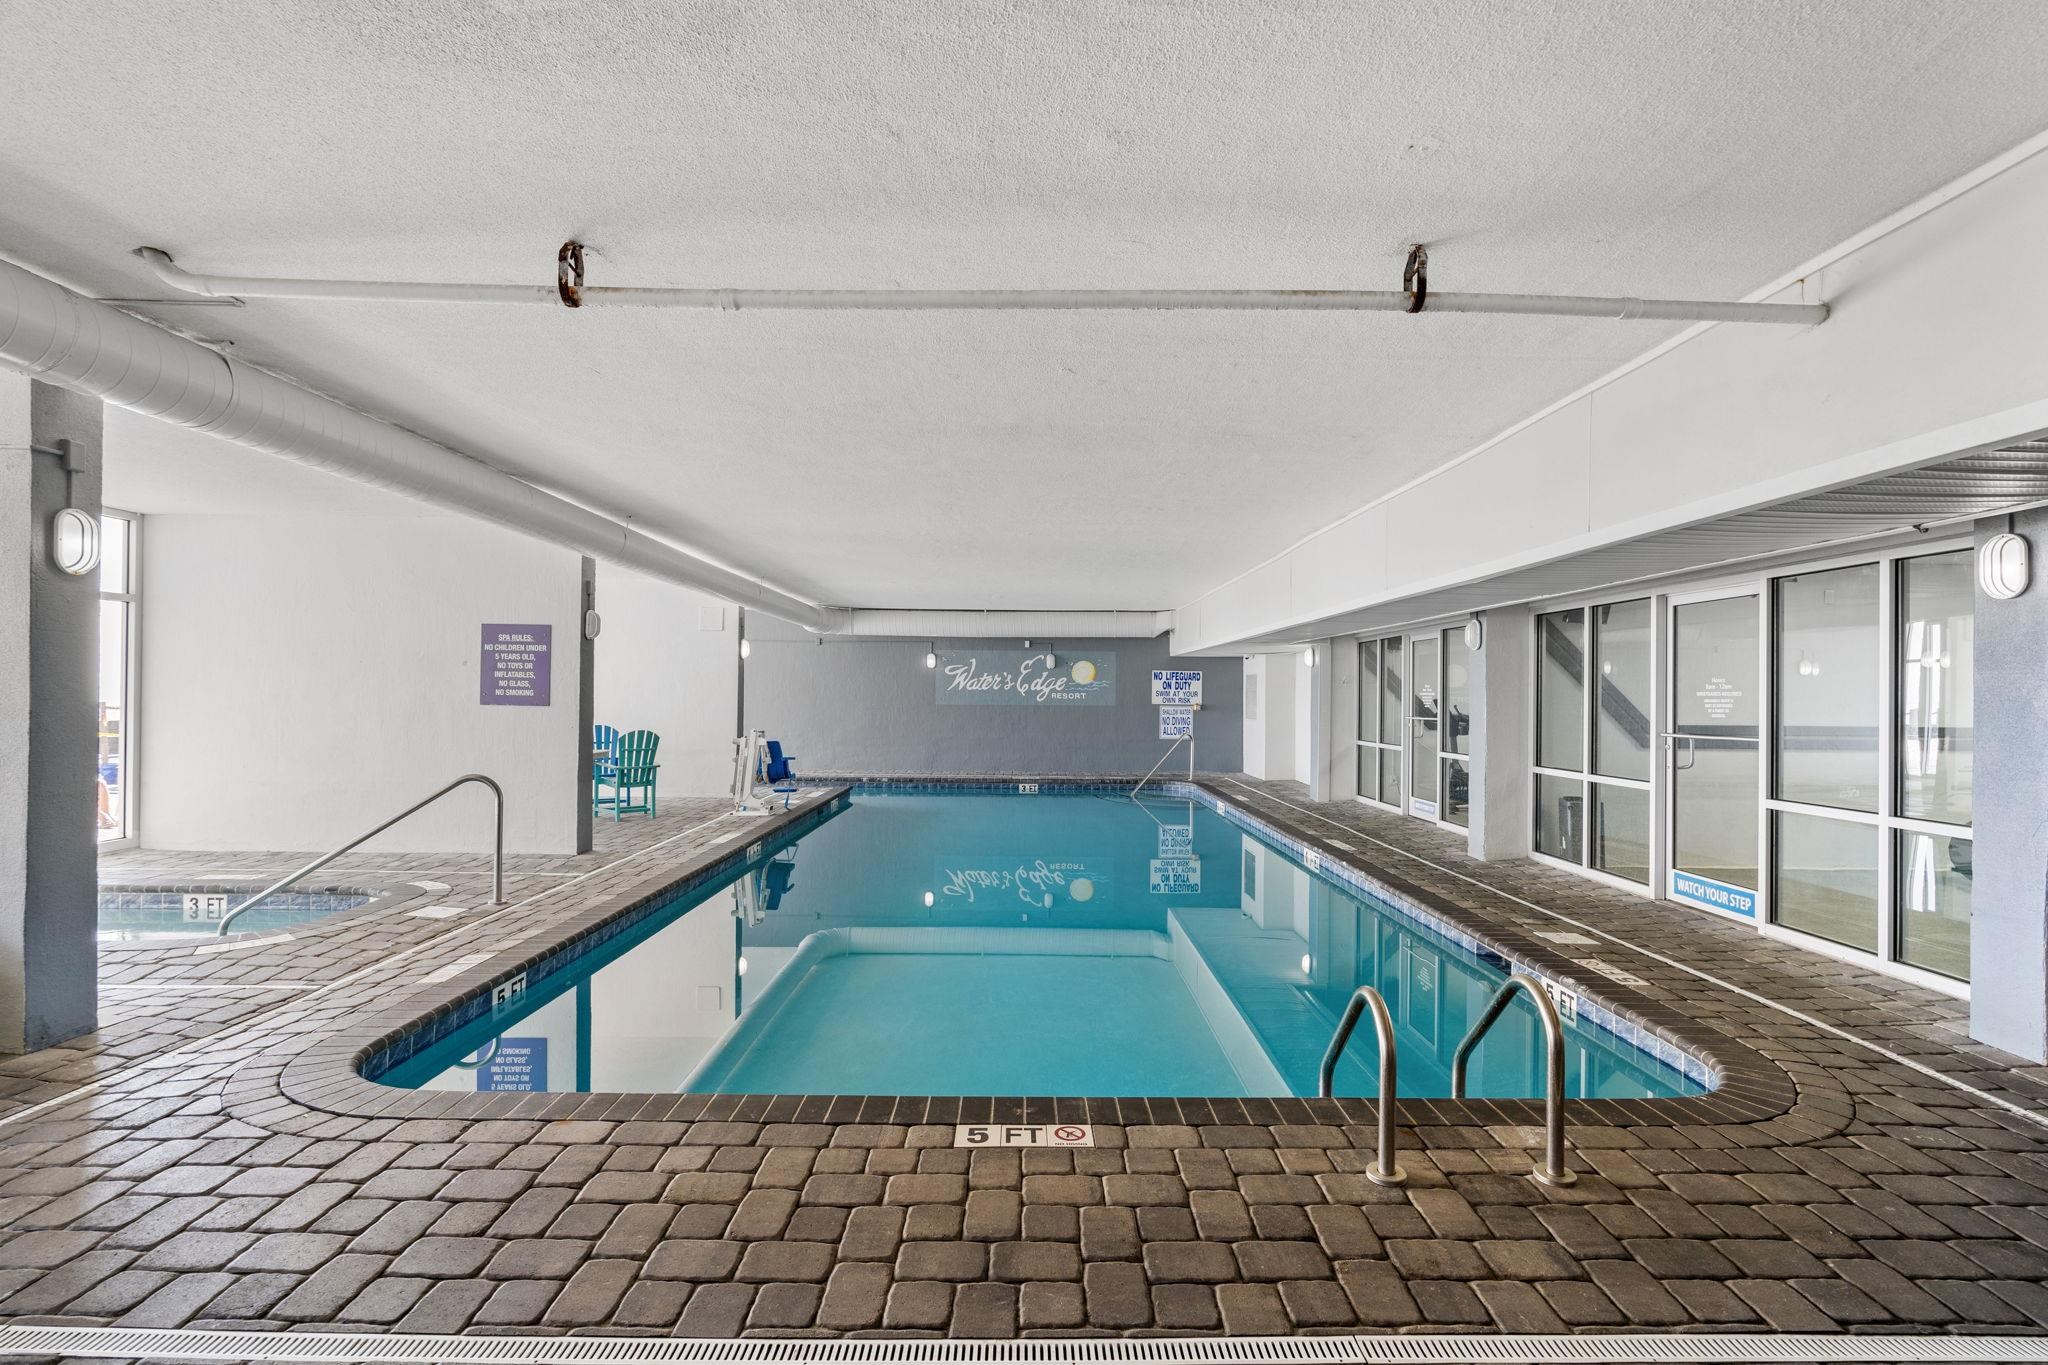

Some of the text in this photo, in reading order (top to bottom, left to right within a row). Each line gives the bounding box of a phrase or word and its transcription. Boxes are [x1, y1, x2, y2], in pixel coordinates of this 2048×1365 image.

[498, 634, 534, 642] SPA RULES:
[525, 644, 547, 652] UNDER
[521, 653, 536, 661] OLD,
[494, 671, 536, 679] INFLATABLES,
[944, 655, 1067, 702] Water's Edge
[1153, 671, 1201, 681] NO LIFEGUARD
[508, 680, 531, 688] GLASS,
[1162, 681, 1192, 690] ON DUTY
[1162, 717, 1191, 725] NO DIVING
[1162, 727, 1190, 735] ALLOWED
[1676, 878, 1751, 911] WATCH YOUR STEP
[190, 897, 199, 911] 3
[498, 976, 525, 1005] 5 FT
[1546, 983, 1555, 1001] 5
[966, 1127, 1043, 1143] 5 FT
